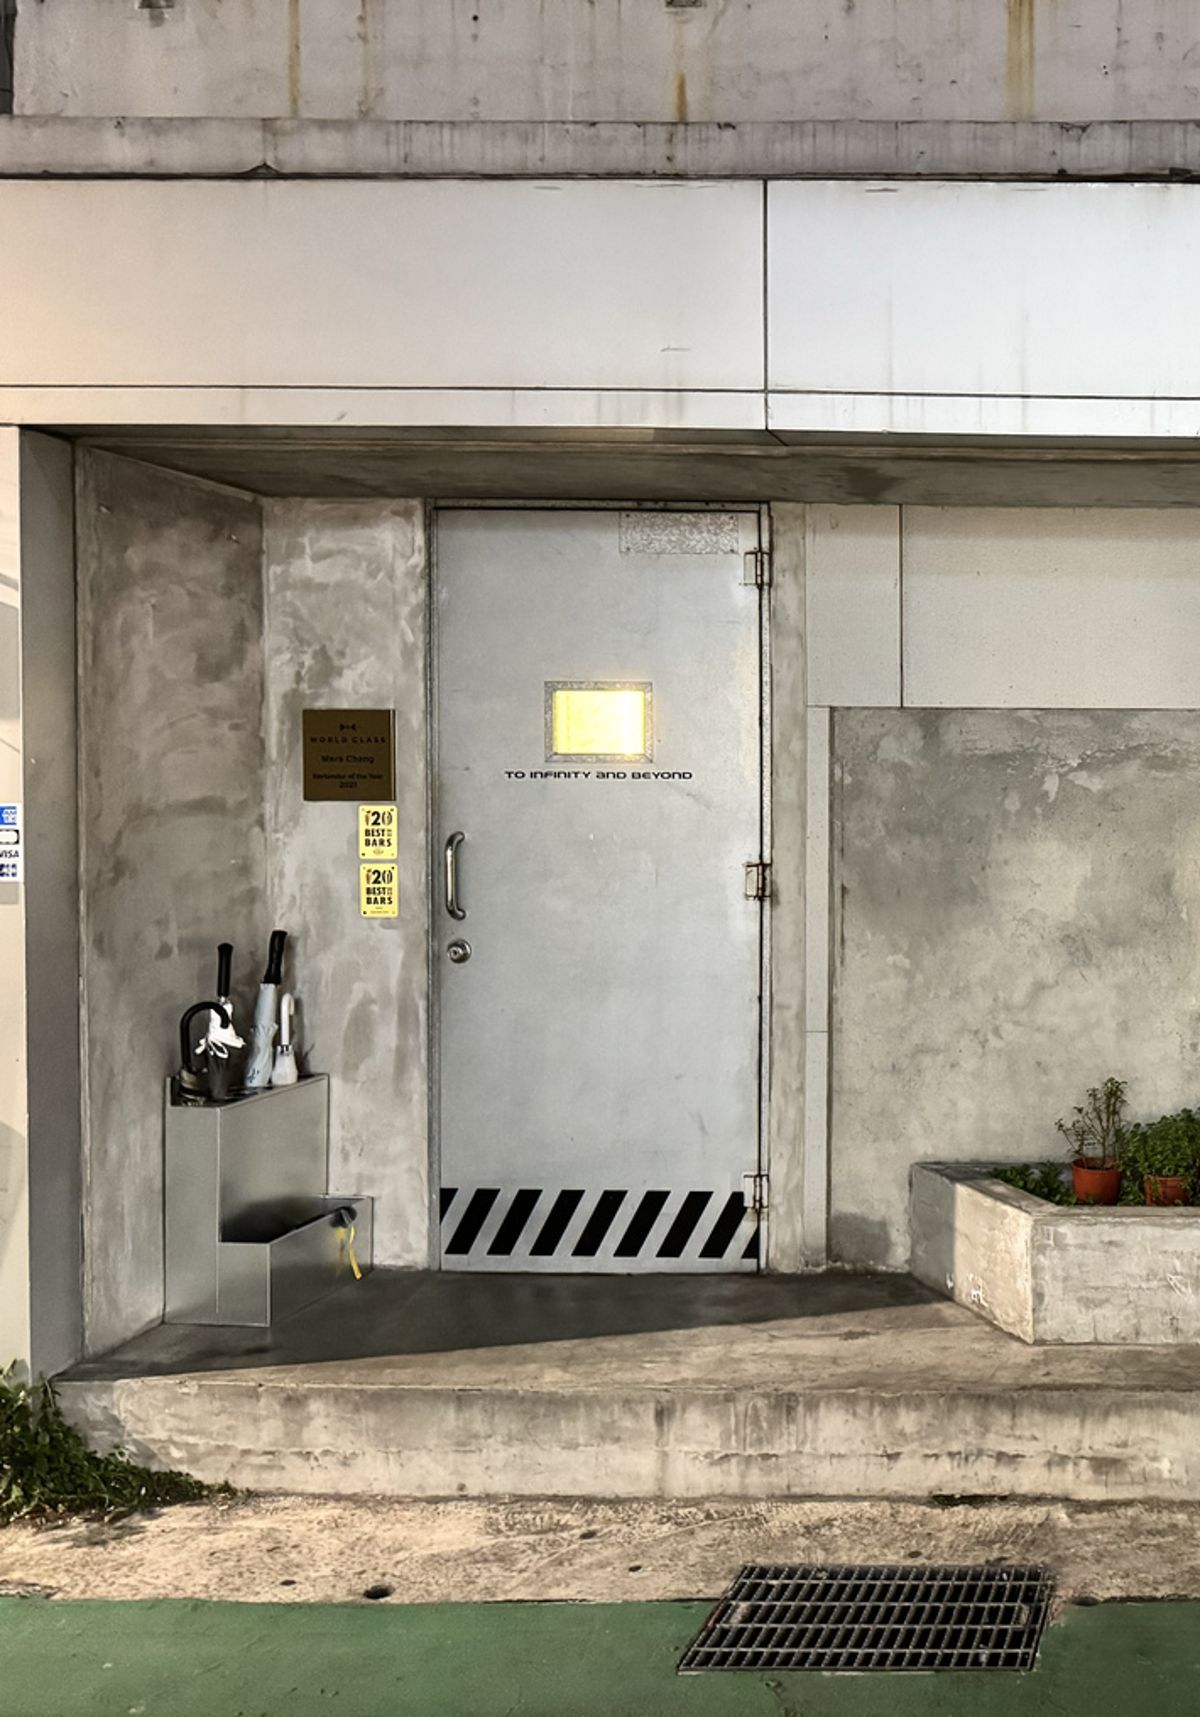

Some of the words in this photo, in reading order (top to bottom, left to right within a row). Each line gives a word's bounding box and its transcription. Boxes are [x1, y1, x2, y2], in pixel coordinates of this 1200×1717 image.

[309, 736, 348, 744] WORLD
[351, 736, 386, 744] CLASS
[505, 771, 526, 780] TO
[530, 771, 591, 780] INFINITY
[631, 771, 693, 780] BEYOND
[365, 829, 385, 837] BEST
[365, 838, 392, 847] BARS
[366, 887, 386, 896] BEST
[366, 896, 393, 905] BARS
